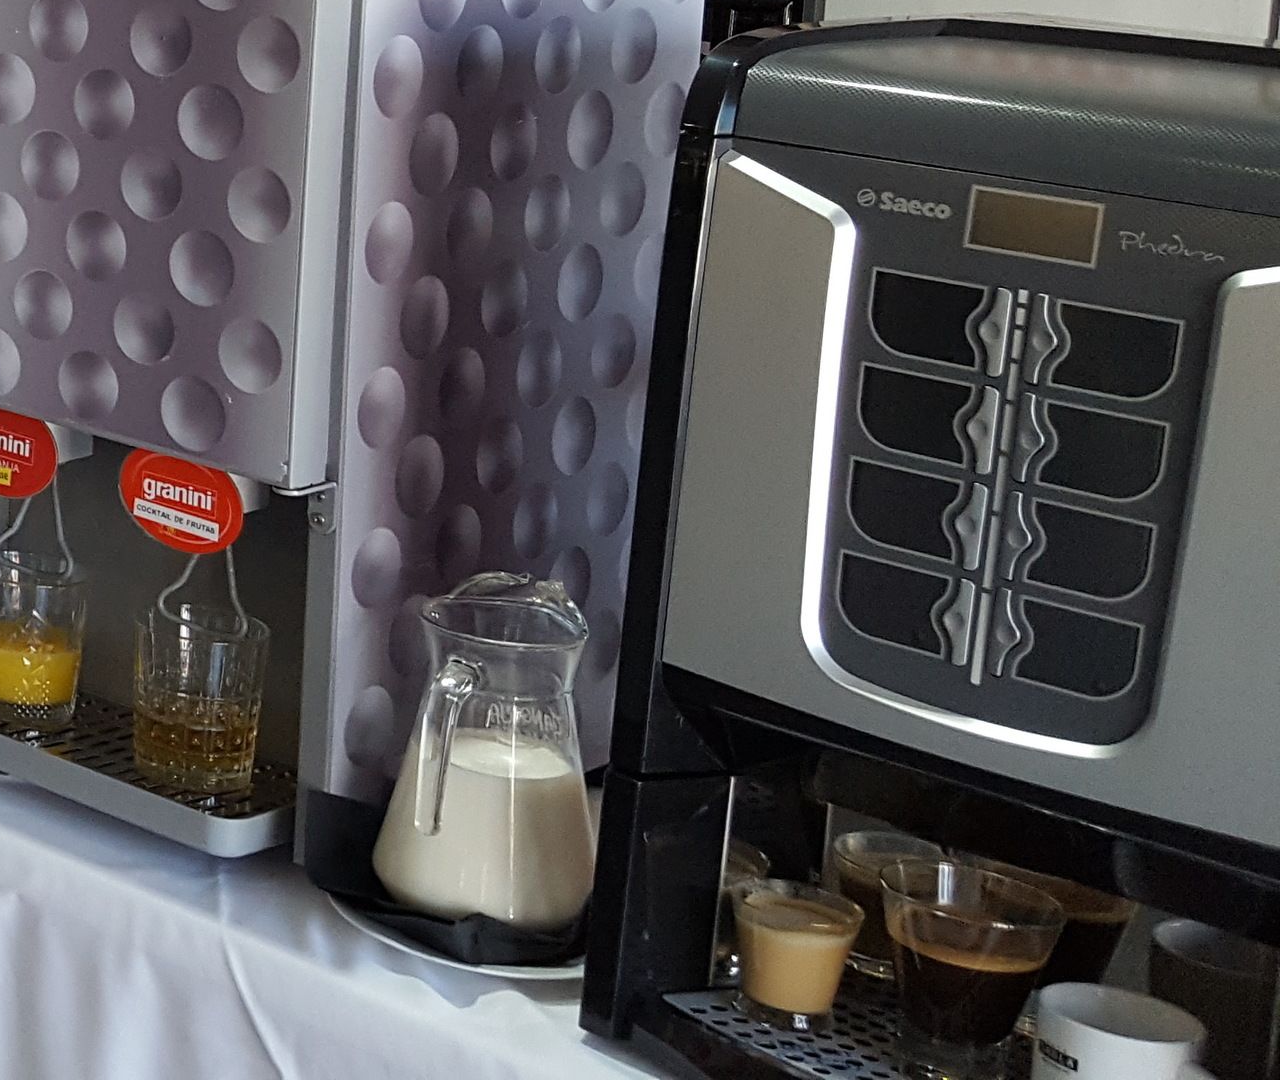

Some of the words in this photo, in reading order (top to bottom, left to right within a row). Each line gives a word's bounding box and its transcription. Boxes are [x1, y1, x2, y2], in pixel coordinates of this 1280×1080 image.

[879, 191, 952, 220] Saeco
[143, 476, 213, 511] granini
[136, 503, 172, 521] COCKTAIL
[173, 515, 184, 525] DE
[186, 519, 216, 535] FRUTAS
